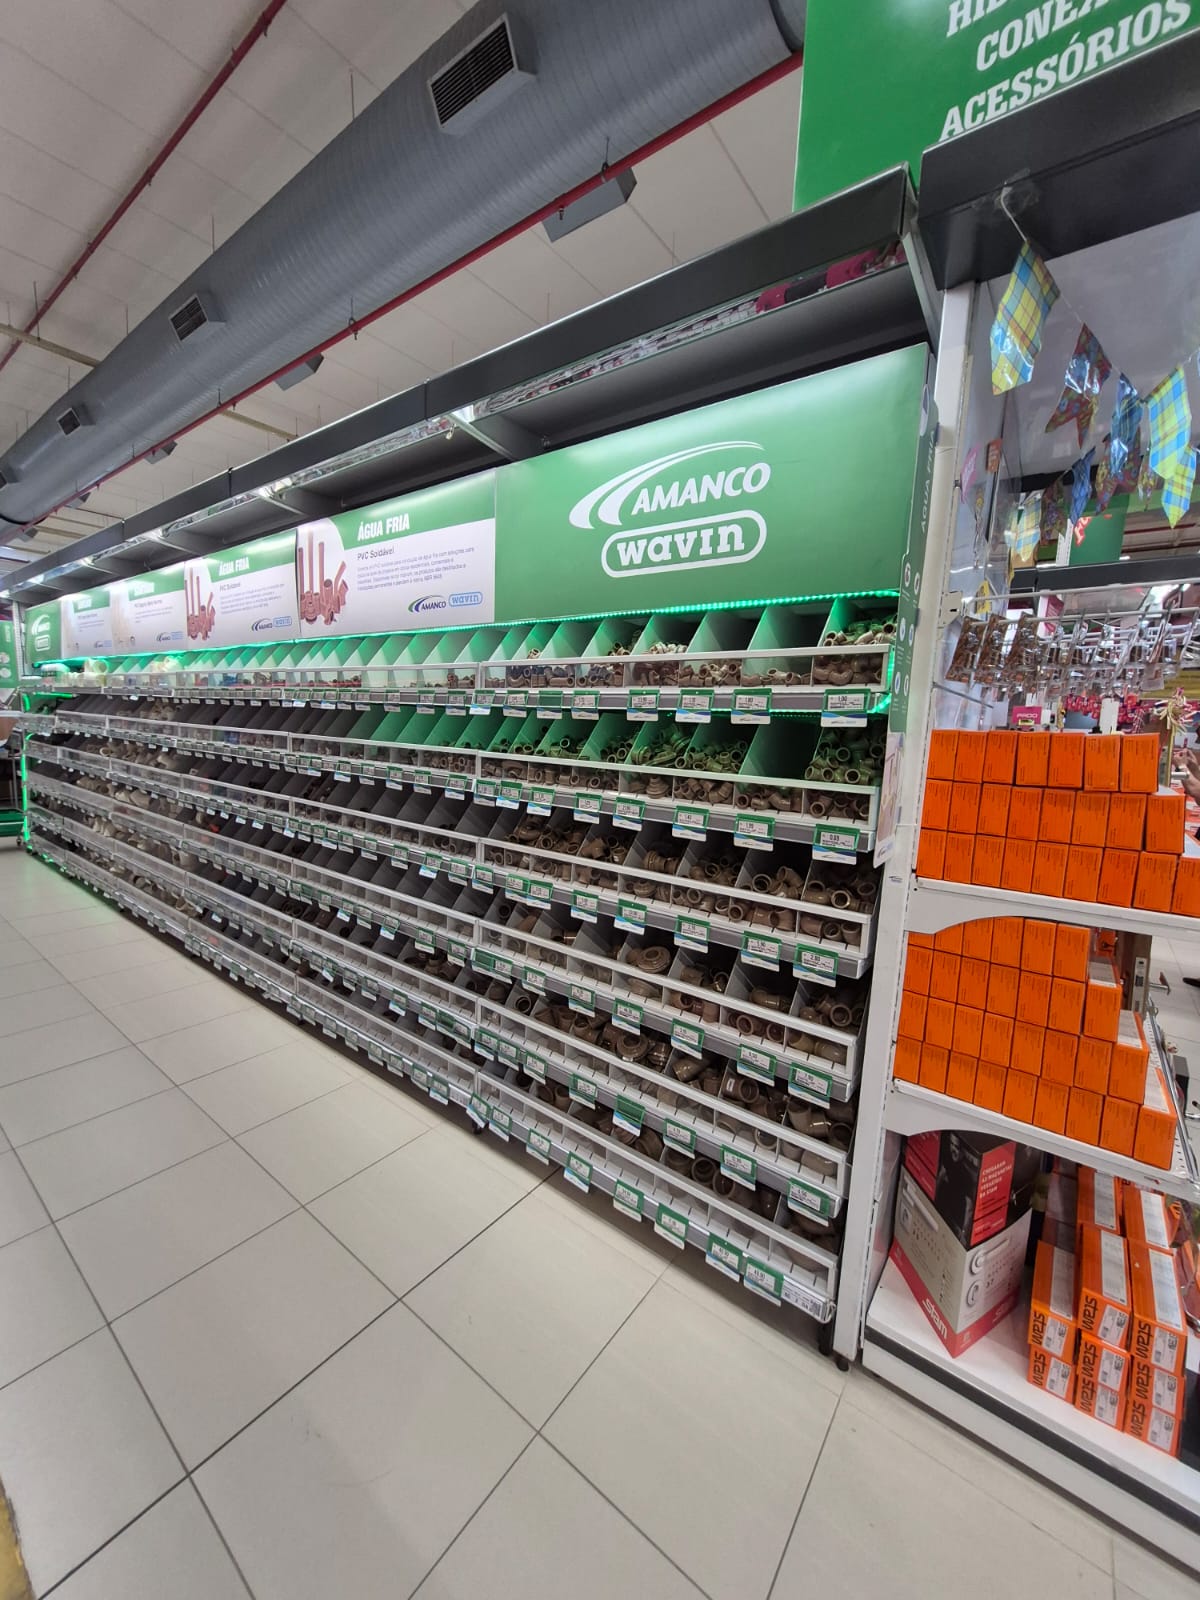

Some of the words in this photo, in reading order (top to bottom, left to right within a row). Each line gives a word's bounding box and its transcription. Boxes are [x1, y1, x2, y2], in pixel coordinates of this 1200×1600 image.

[939, 0, 1191, 142] ACESSÓRIOS
[631, 462, 771, 515] AMANCO
[357, 521, 383, 541] ÁGUA
[386, 513, 410, 535] FRIA
[617, 523, 744, 566] wavin
[357, 551, 369, 560] PVC
[421, 601, 446, 611] AMANCO
[922, 1298, 948, 1339] stam
[1032, 1311, 1046, 1345] stam
[1083, 1296, 1097, 1330] stam
[1136, 1320, 1152, 1359] stam
[1033, 1351, 1046, 1386] stam
[1082, 1342, 1097, 1377] stam
[1080, 1378, 1096, 1412] stam
[1136, 1362, 1151, 1399] stam
